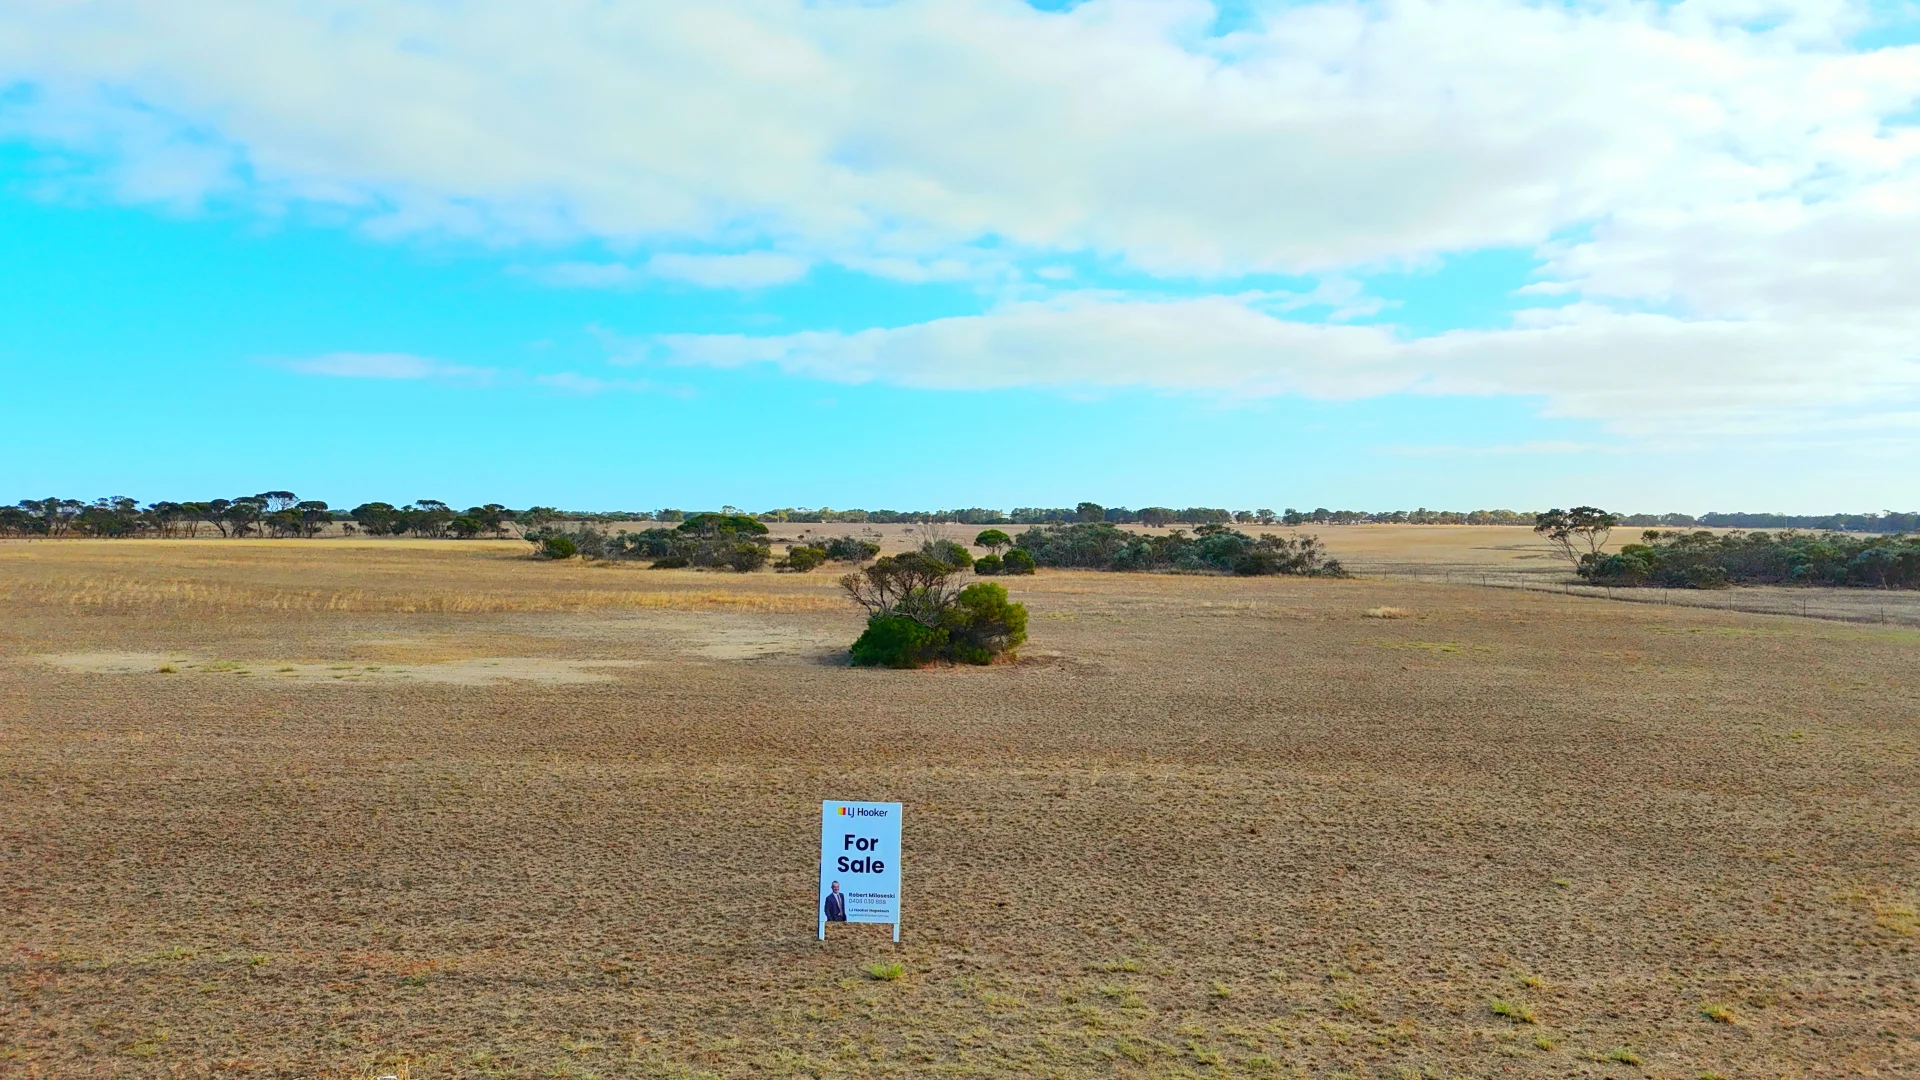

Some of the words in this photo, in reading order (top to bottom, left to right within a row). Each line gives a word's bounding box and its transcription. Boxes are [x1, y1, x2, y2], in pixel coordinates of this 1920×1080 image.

[847, 807, 855, 818] LJ
[857, 807, 888, 817] Hooker
[844, 834, 879, 851] For
[837, 856, 885, 874] Sale
